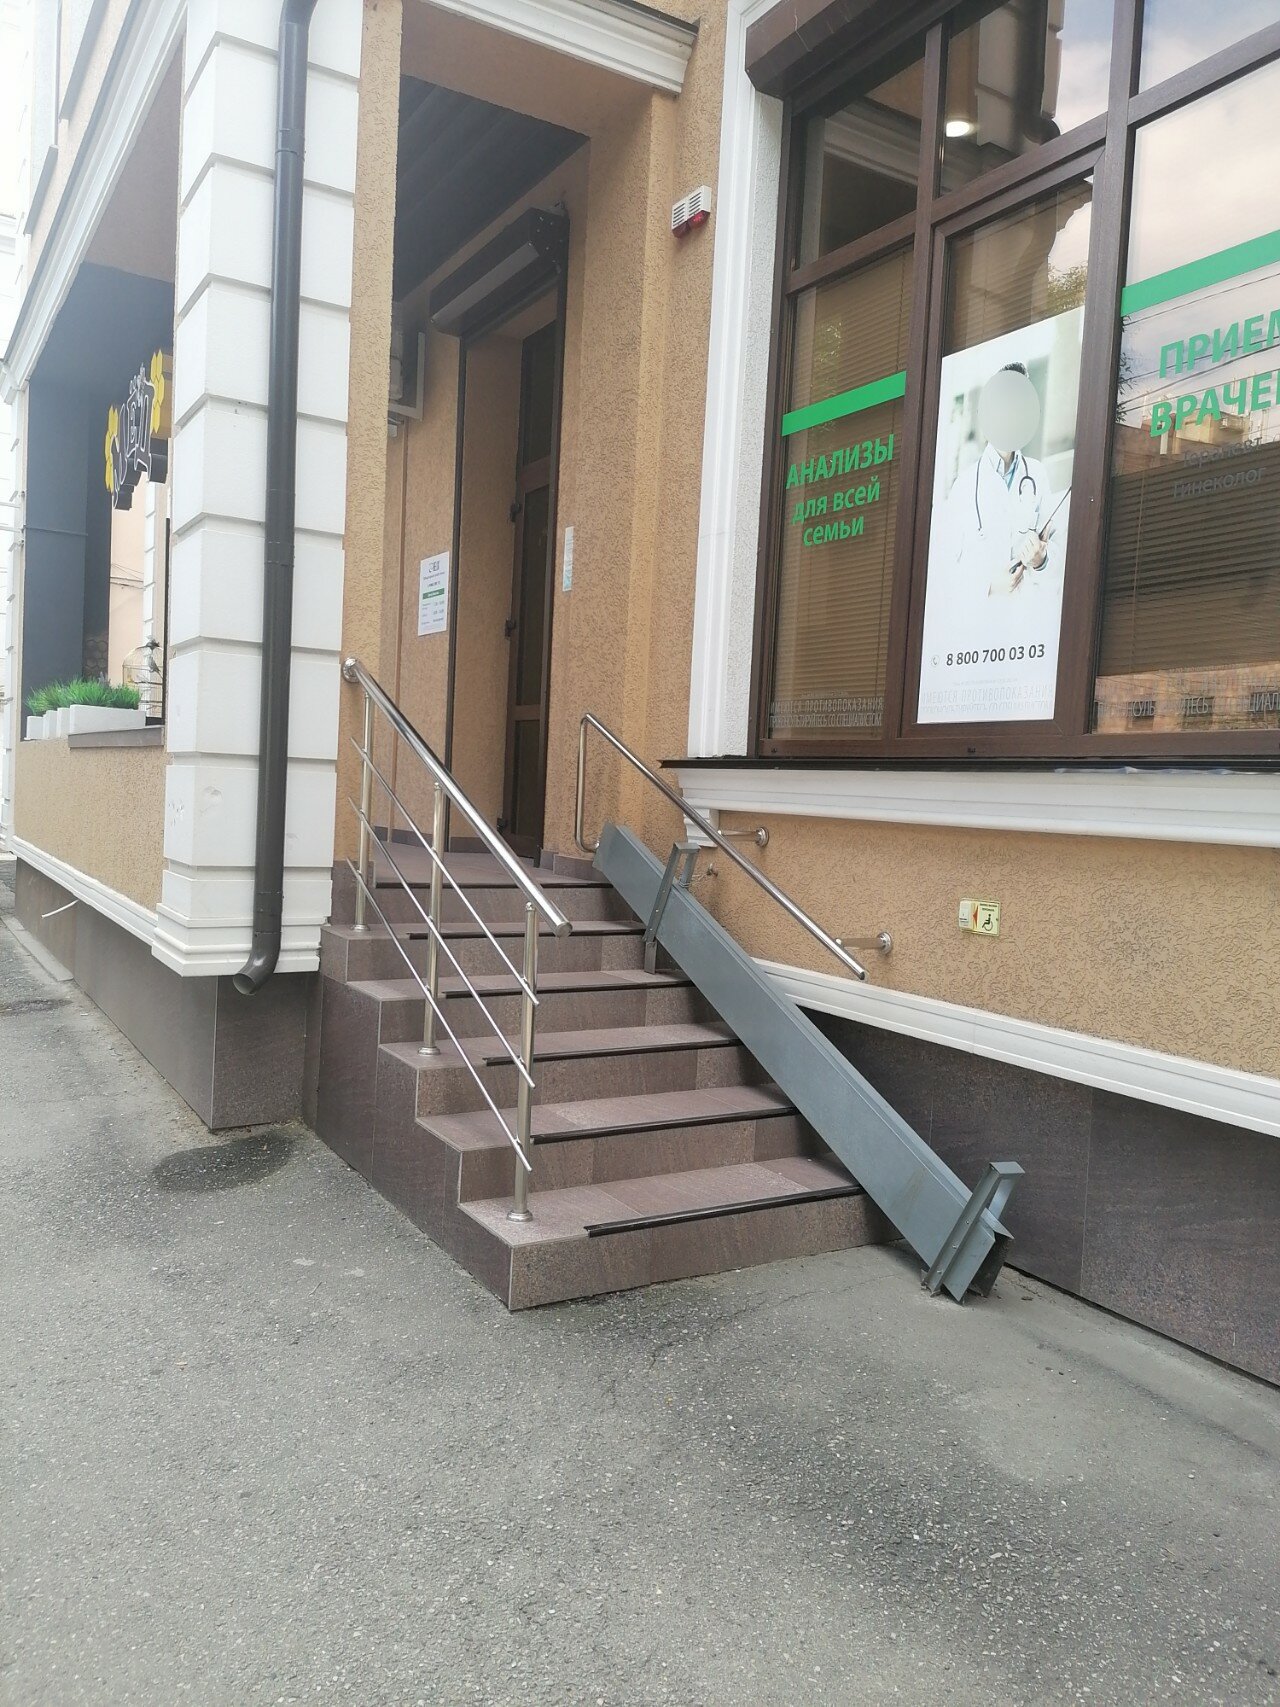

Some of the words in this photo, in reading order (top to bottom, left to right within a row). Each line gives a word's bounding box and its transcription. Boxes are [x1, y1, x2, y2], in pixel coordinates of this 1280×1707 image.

[1150, 371, 1280, 437] ВРАЧЕ
[785, 433, 894, 489] АНАЛИЗЫ
[791, 495, 827, 525] для
[832, 475, 880, 512] всей
[1173, 467, 1267, 498] Гинеколог
[803, 515, 864, 547] семьи
[946, 653, 954, 666] 8
[956, 650, 979, 665] 800
[982, 648, 1005, 663] 700
[1009, 646, 1025, 660] 03
[1028, 644, 1045, 658] 03
